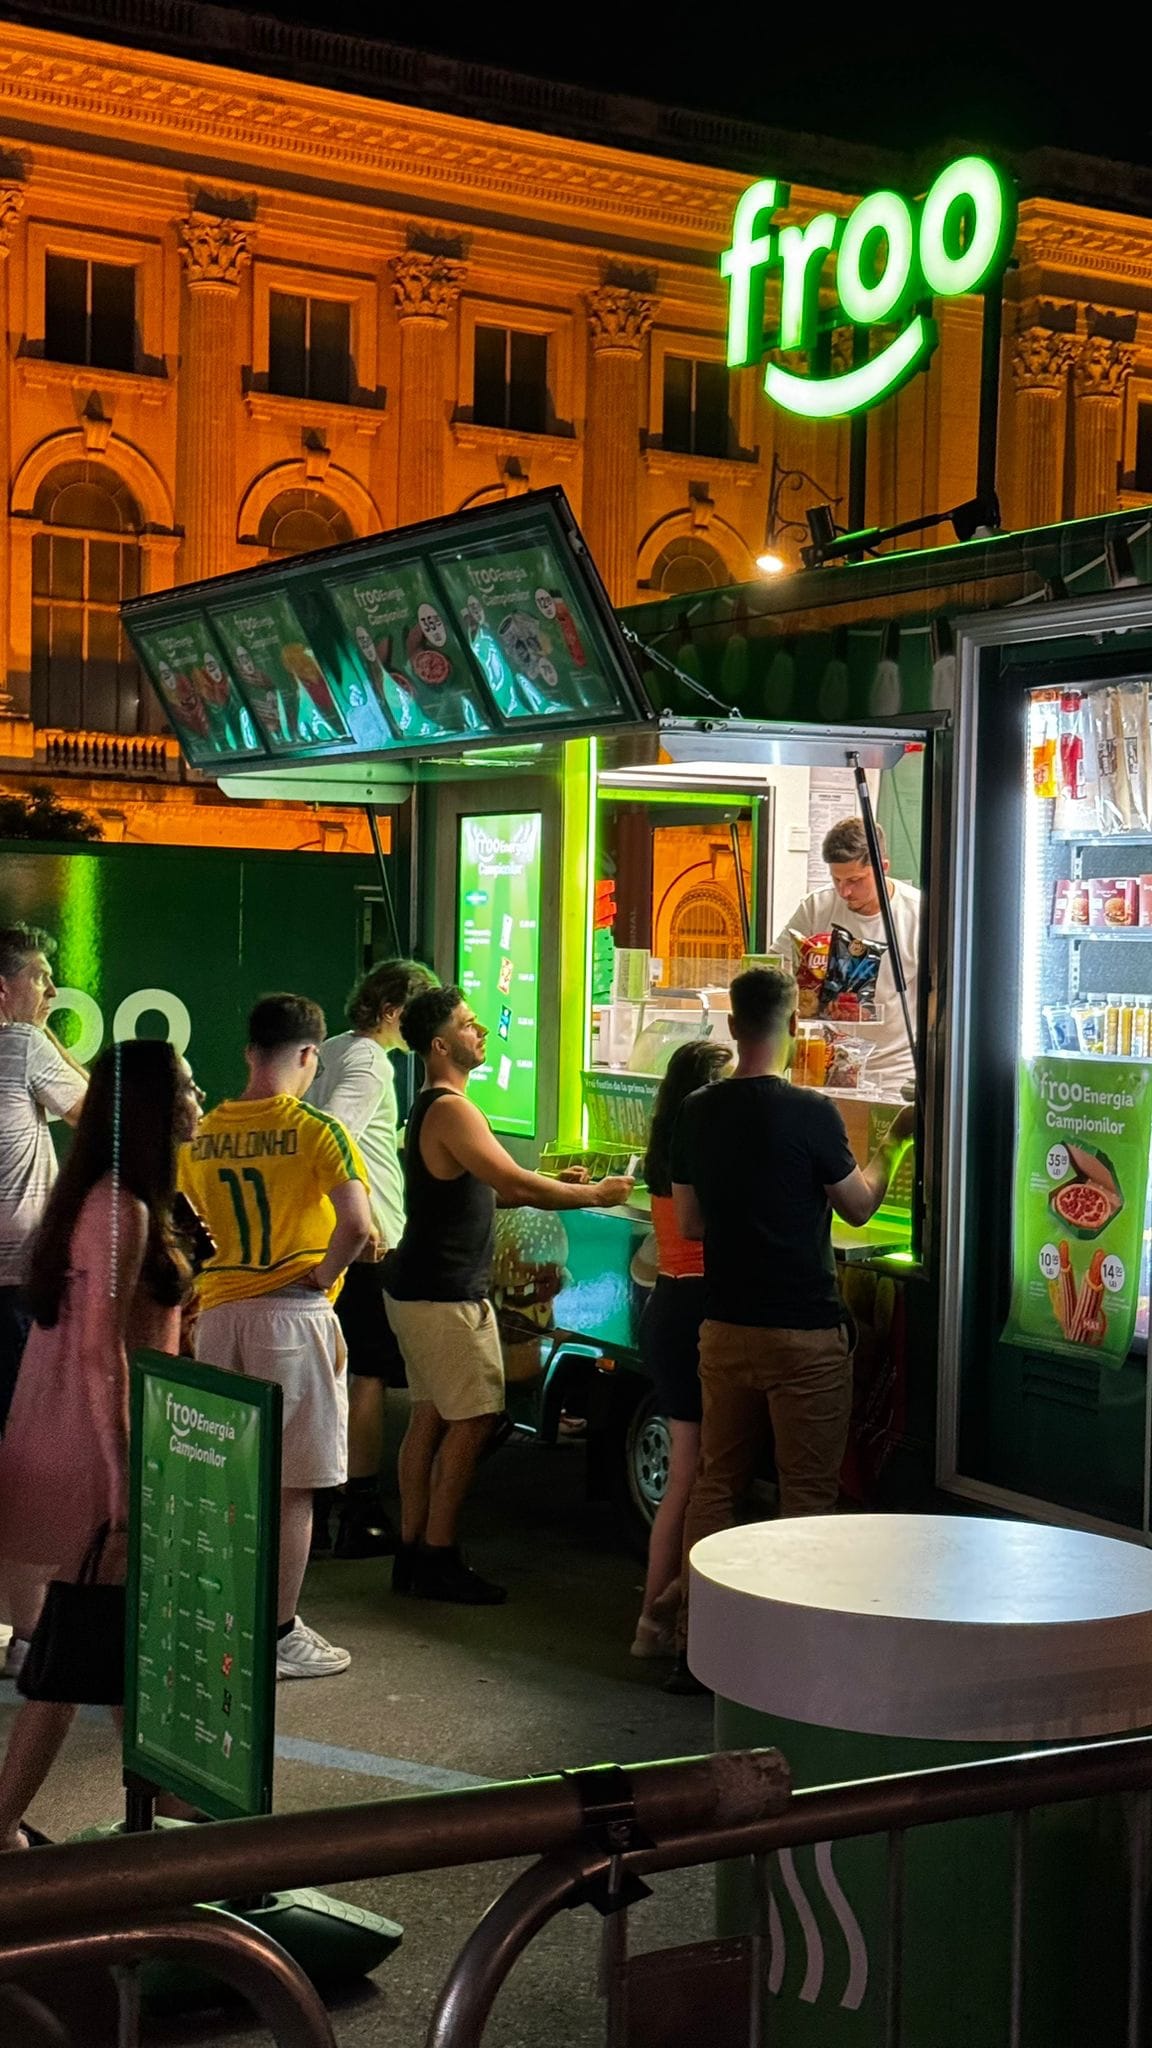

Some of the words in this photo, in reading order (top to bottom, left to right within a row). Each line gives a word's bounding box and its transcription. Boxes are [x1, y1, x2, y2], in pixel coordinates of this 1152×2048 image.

[719, 156, 1004, 368] froo
[1046, 1111, 1126, 1135] Campionilor
[218, 1167, 272, 1266] 11
[169, 1434, 228, 1469] Campionilor
